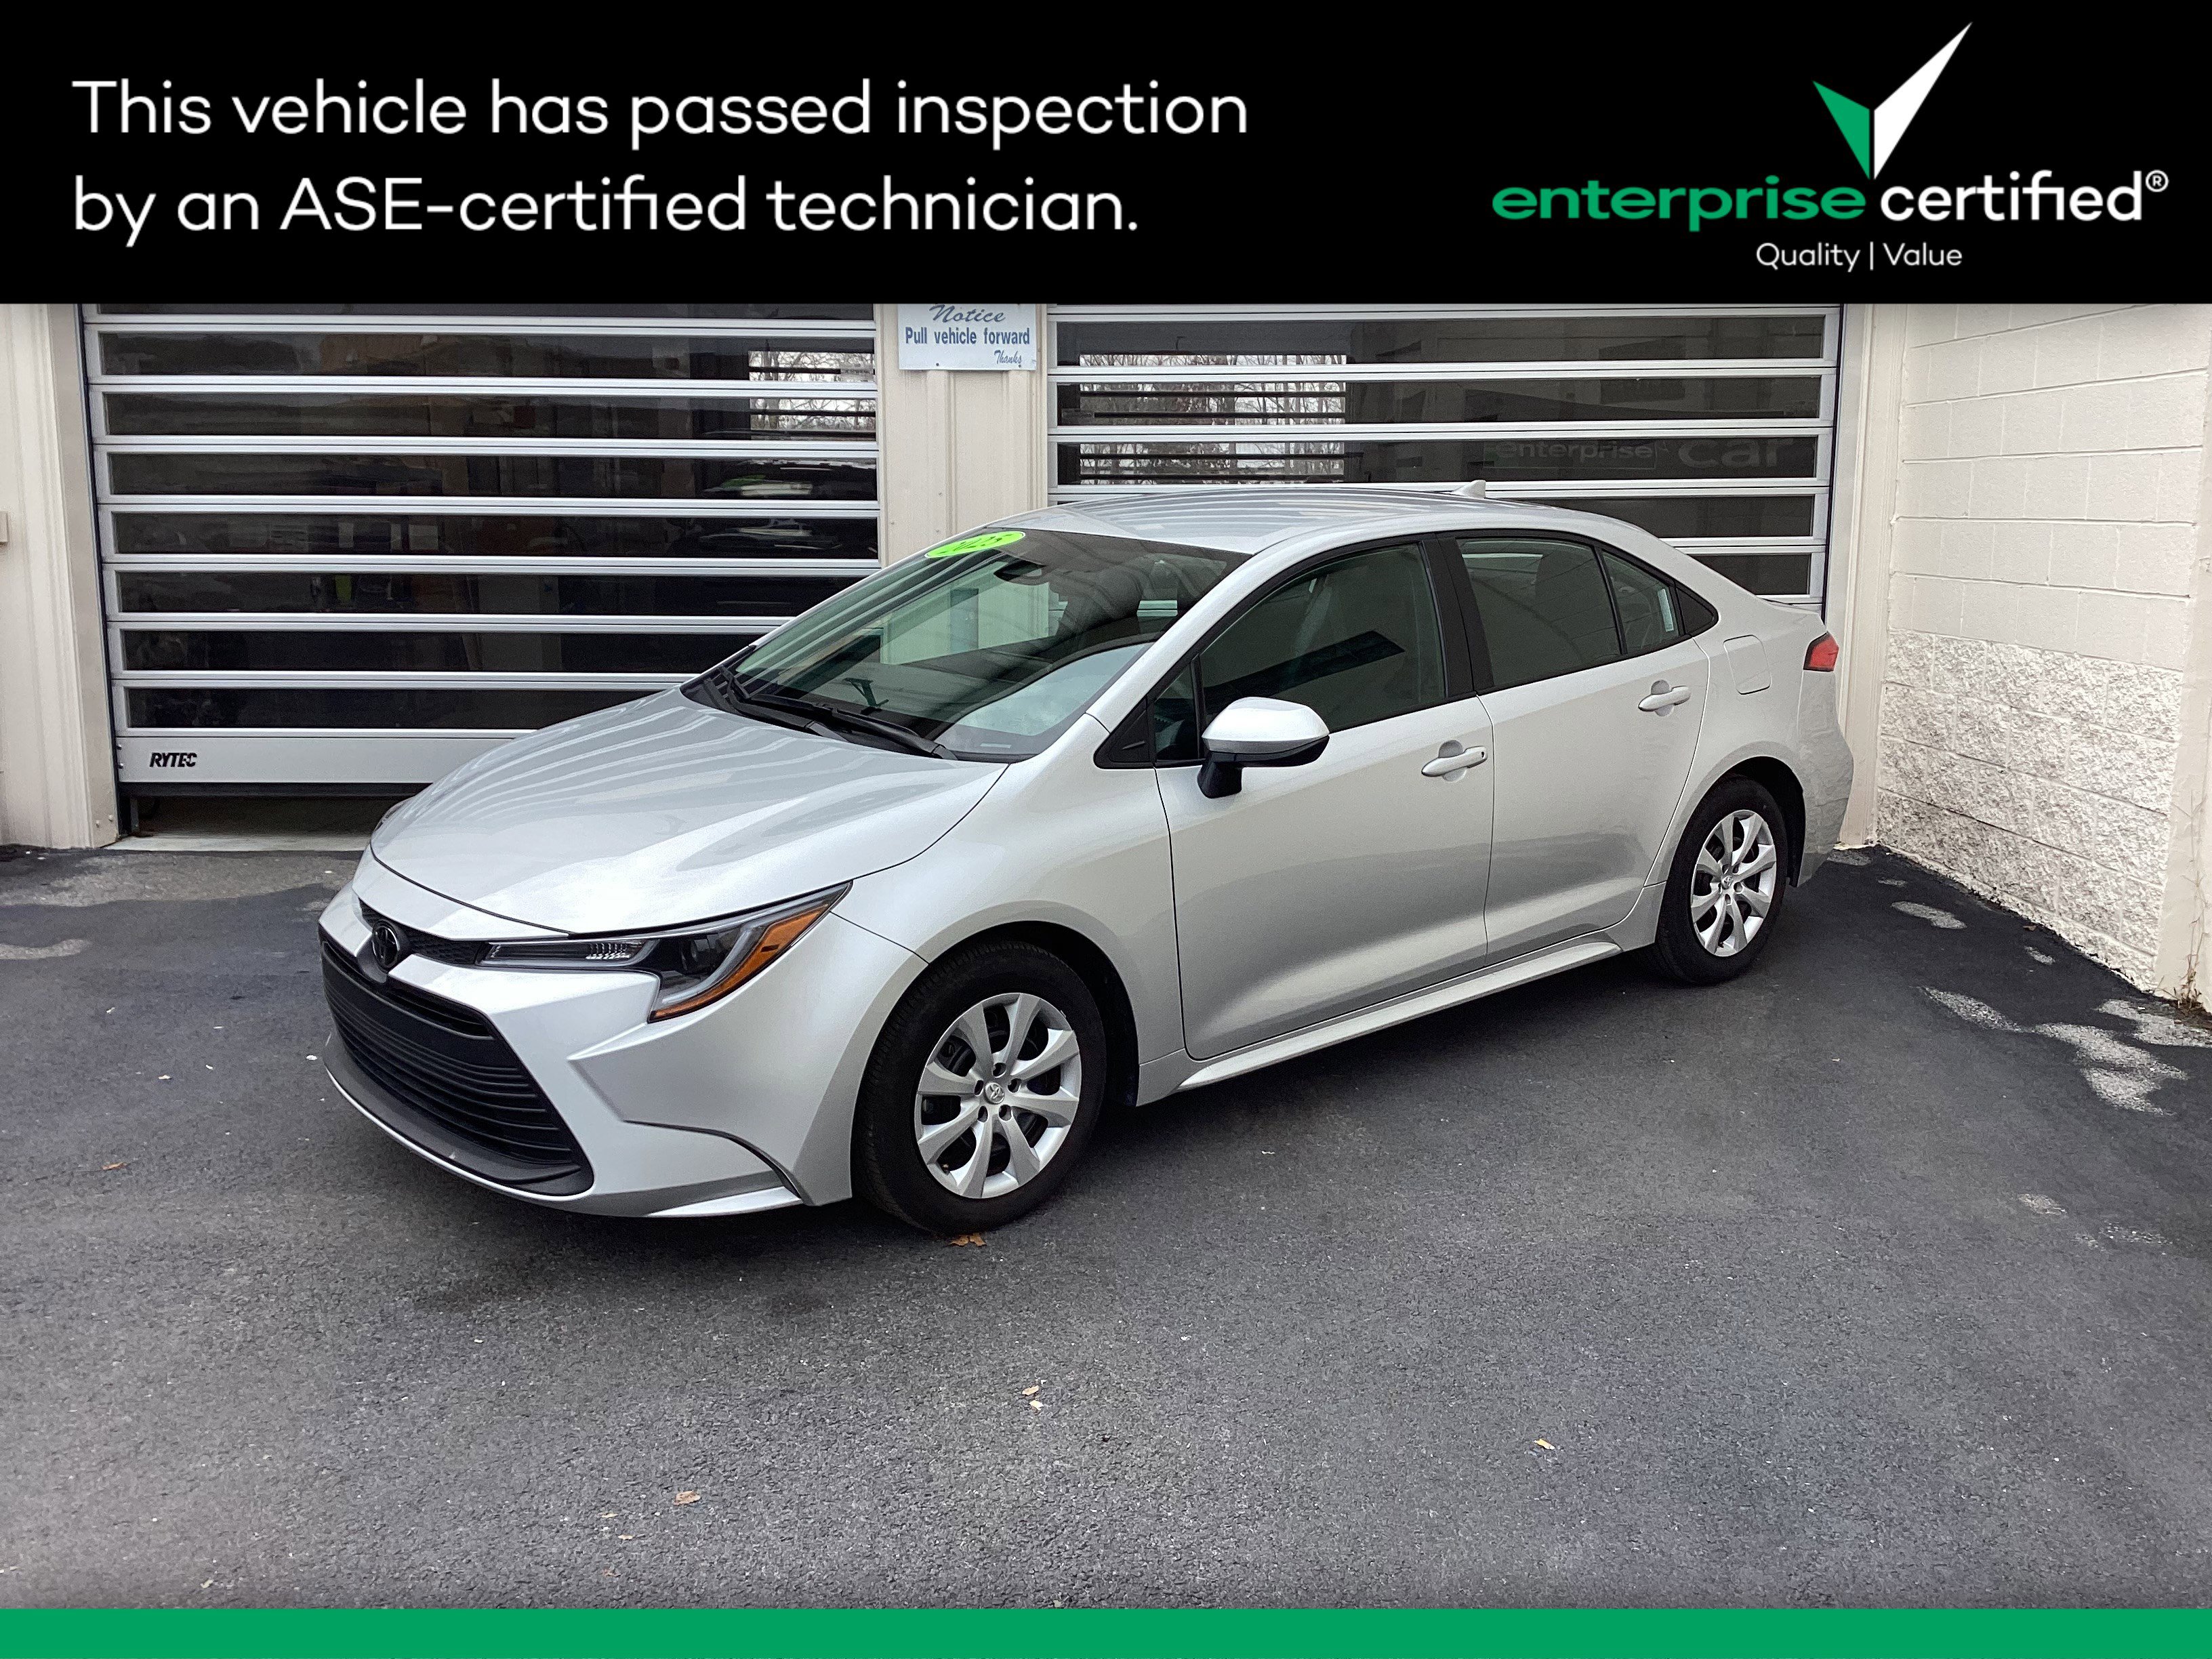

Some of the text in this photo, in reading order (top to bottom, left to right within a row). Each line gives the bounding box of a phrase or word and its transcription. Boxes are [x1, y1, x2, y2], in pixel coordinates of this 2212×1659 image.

[929, 304, 1006, 323] Notice
[905, 327, 1029, 344] Pull vehicle forward
[994, 350, 1022, 364] Thanks
[1496, 439, 1794, 467] enterprise car
[149, 752, 197, 767] RYTEC
